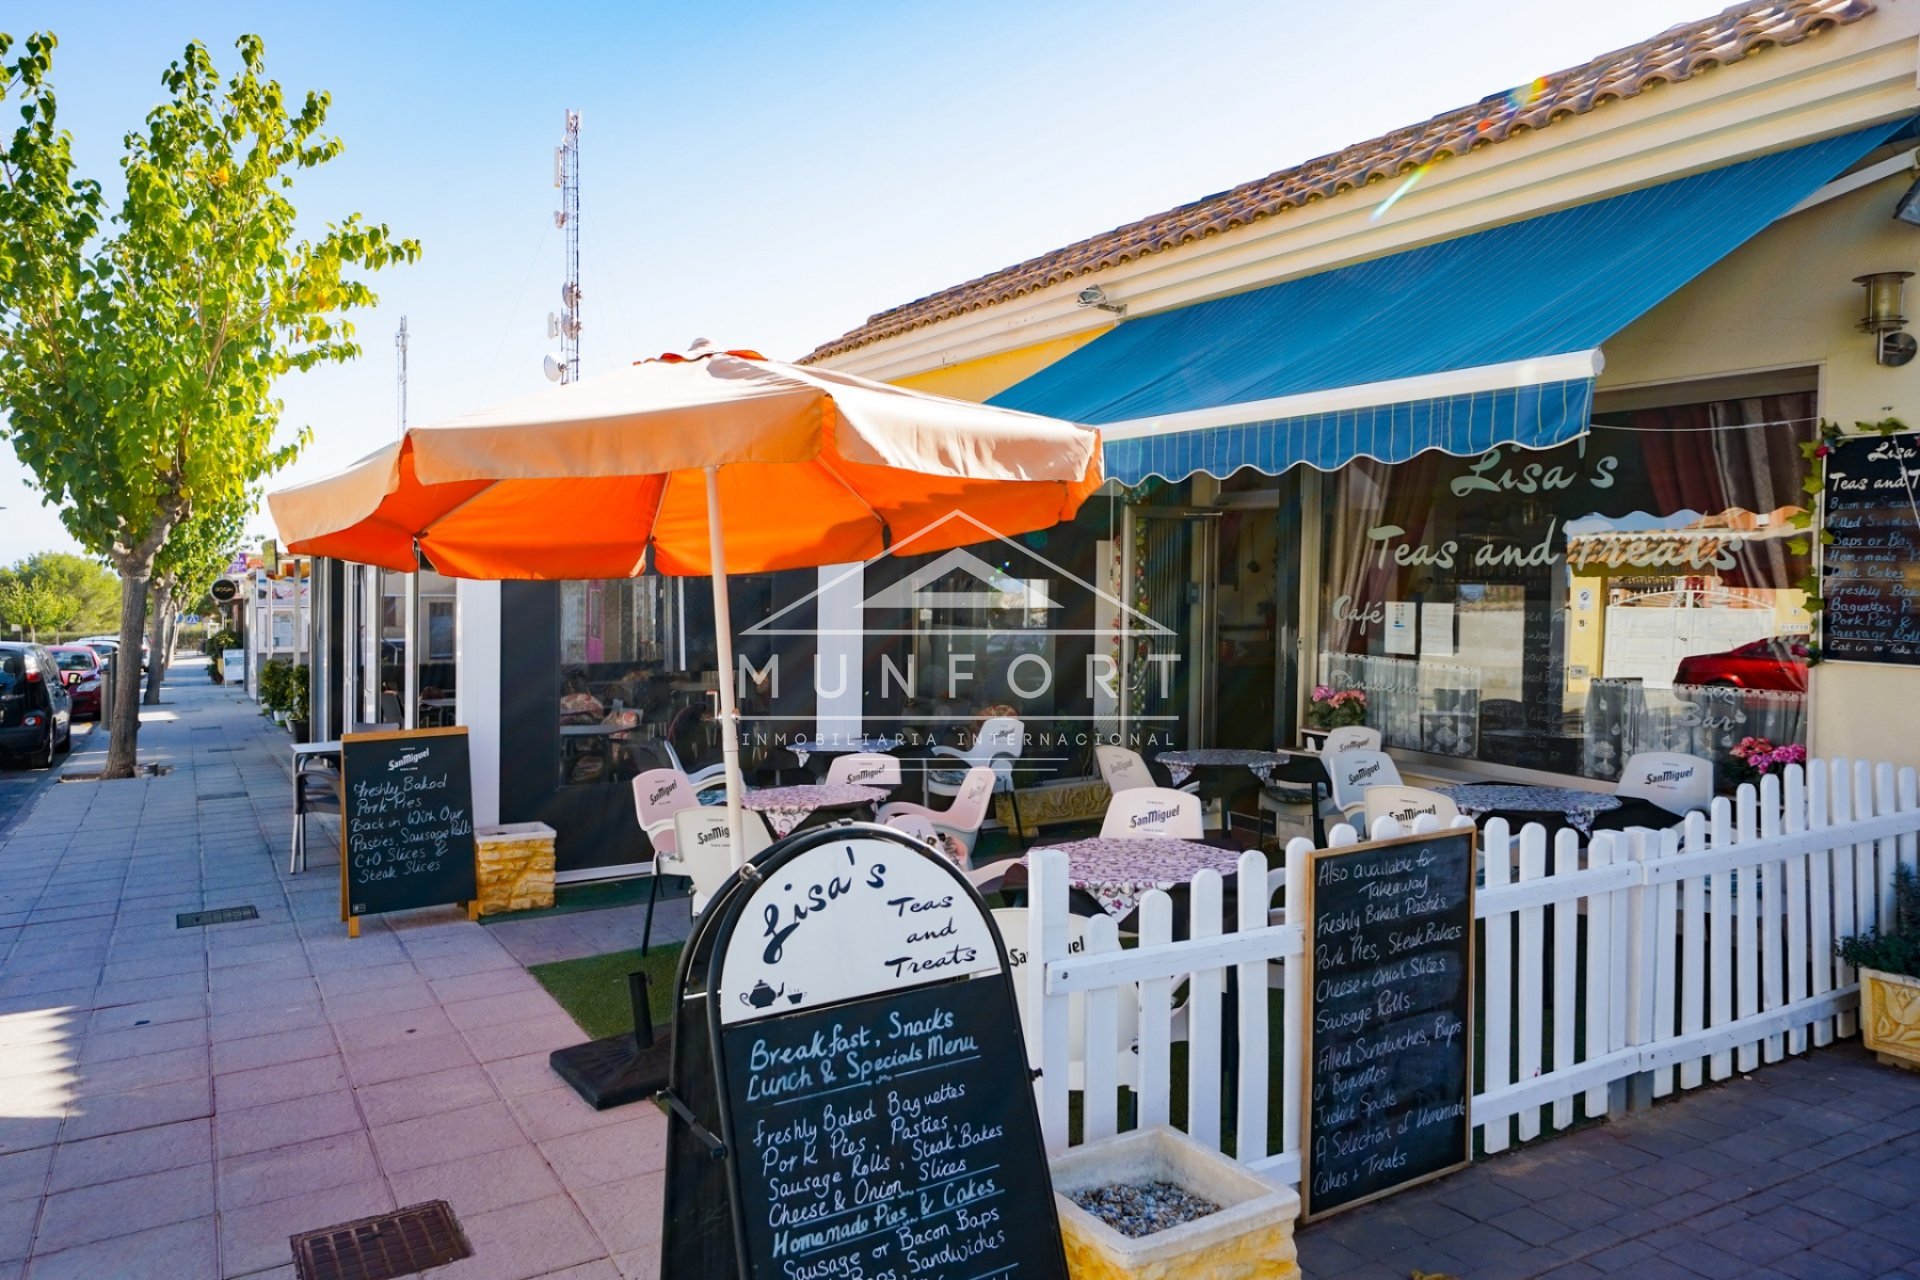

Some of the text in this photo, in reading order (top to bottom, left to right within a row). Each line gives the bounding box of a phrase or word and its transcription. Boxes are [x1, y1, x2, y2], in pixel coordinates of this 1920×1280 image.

[1450, 435, 1618, 497] Lisa's
[1829, 472, 1868, 491] Teas
[1874, 474, 1906, 489] and
[1367, 512, 1743, 572] Teas and Treats
[1868, 537, 1883, 546] or
[1830, 582, 1881, 598] Freshly
[1332, 595, 1385, 635] Café
[1831, 612, 1864, 625] Pork
[1867, 611, 1892, 626] Pies
[1828, 626, 1886, 642] Sausage
[1830, 640, 1851, 651] Eat
[1856, 643, 1867, 651] in
[1678, 701, 1735, 732] Bar
[387, 747, 430, 771] SanMiguel
[1348, 761, 1380, 785] SanMiguel
[1644, 767, 1694, 785] SanMiguel
[351, 817, 385, 833] Back
[408, 809, 437, 825] With
[439, 805, 463, 822] Our
[356, 792, 422, 817] Pork Pies
[1129, 804, 1180, 829] SanMiguel
[400, 827, 449, 844] Sausage
[451, 819, 472, 837] Rolls
[386, 847, 427, 863] Slices
[358, 858, 440, 884] Steak Slices
[1318, 861, 1348, 886] Also
[1353, 858, 1414, 879] available
[1358, 874, 1429, 900] Takeaway
[887, 895, 954, 917] Teas
[906, 917, 957, 944] and
[1317, 912, 1360, 941] Freshly
[1366, 903, 1400, 924] Baked
[1315, 944, 1347, 971] Pork
[1388, 925, 1425, 955] Steak
[1425, 922, 1463, 943] Bakes
[884, 945, 976, 978] Treats
[1316, 978, 1360, 1003] Cheese
[1410, 957, 1446, 977] Slices
[888, 1008, 954, 1038] Snacks
[1316, 1007, 1372, 1034] Sausage
[1317, 1044, 1352, 1075] Filled
[1434, 1015, 1462, 1047] Baps
[746, 1035, 979, 1101] Lunch & Specials Menu
[1314, 1083, 1326, 1100] or
[823, 1099, 877, 1131] Baked
[887, 1082, 966, 1118] Baguettes
[1314, 1089, 1397, 1128] Jacket Spuds
[1315, 1135, 1327, 1165] A
[1332, 1125, 1392, 1159] Selection
[1397, 1111, 1413, 1134] of
[762, 1144, 818, 1176] Pork
[768, 1172, 843, 1201] Sausage
[911, 1131, 954, 1160] Steak
[958, 1123, 1003, 1148] Bakes
[1314, 1171, 1348, 1196] Cakes
[1361, 1147, 1408, 1176] Treats
[768, 1159, 967, 1228] Cheese & Onion Slices
[772, 1177, 995, 1258] Homemade Pies & Cakes
[783, 1208, 1000, 1280] Sausage or Bacon Baps
[907, 1230, 1005, 1273] Sandwiches
